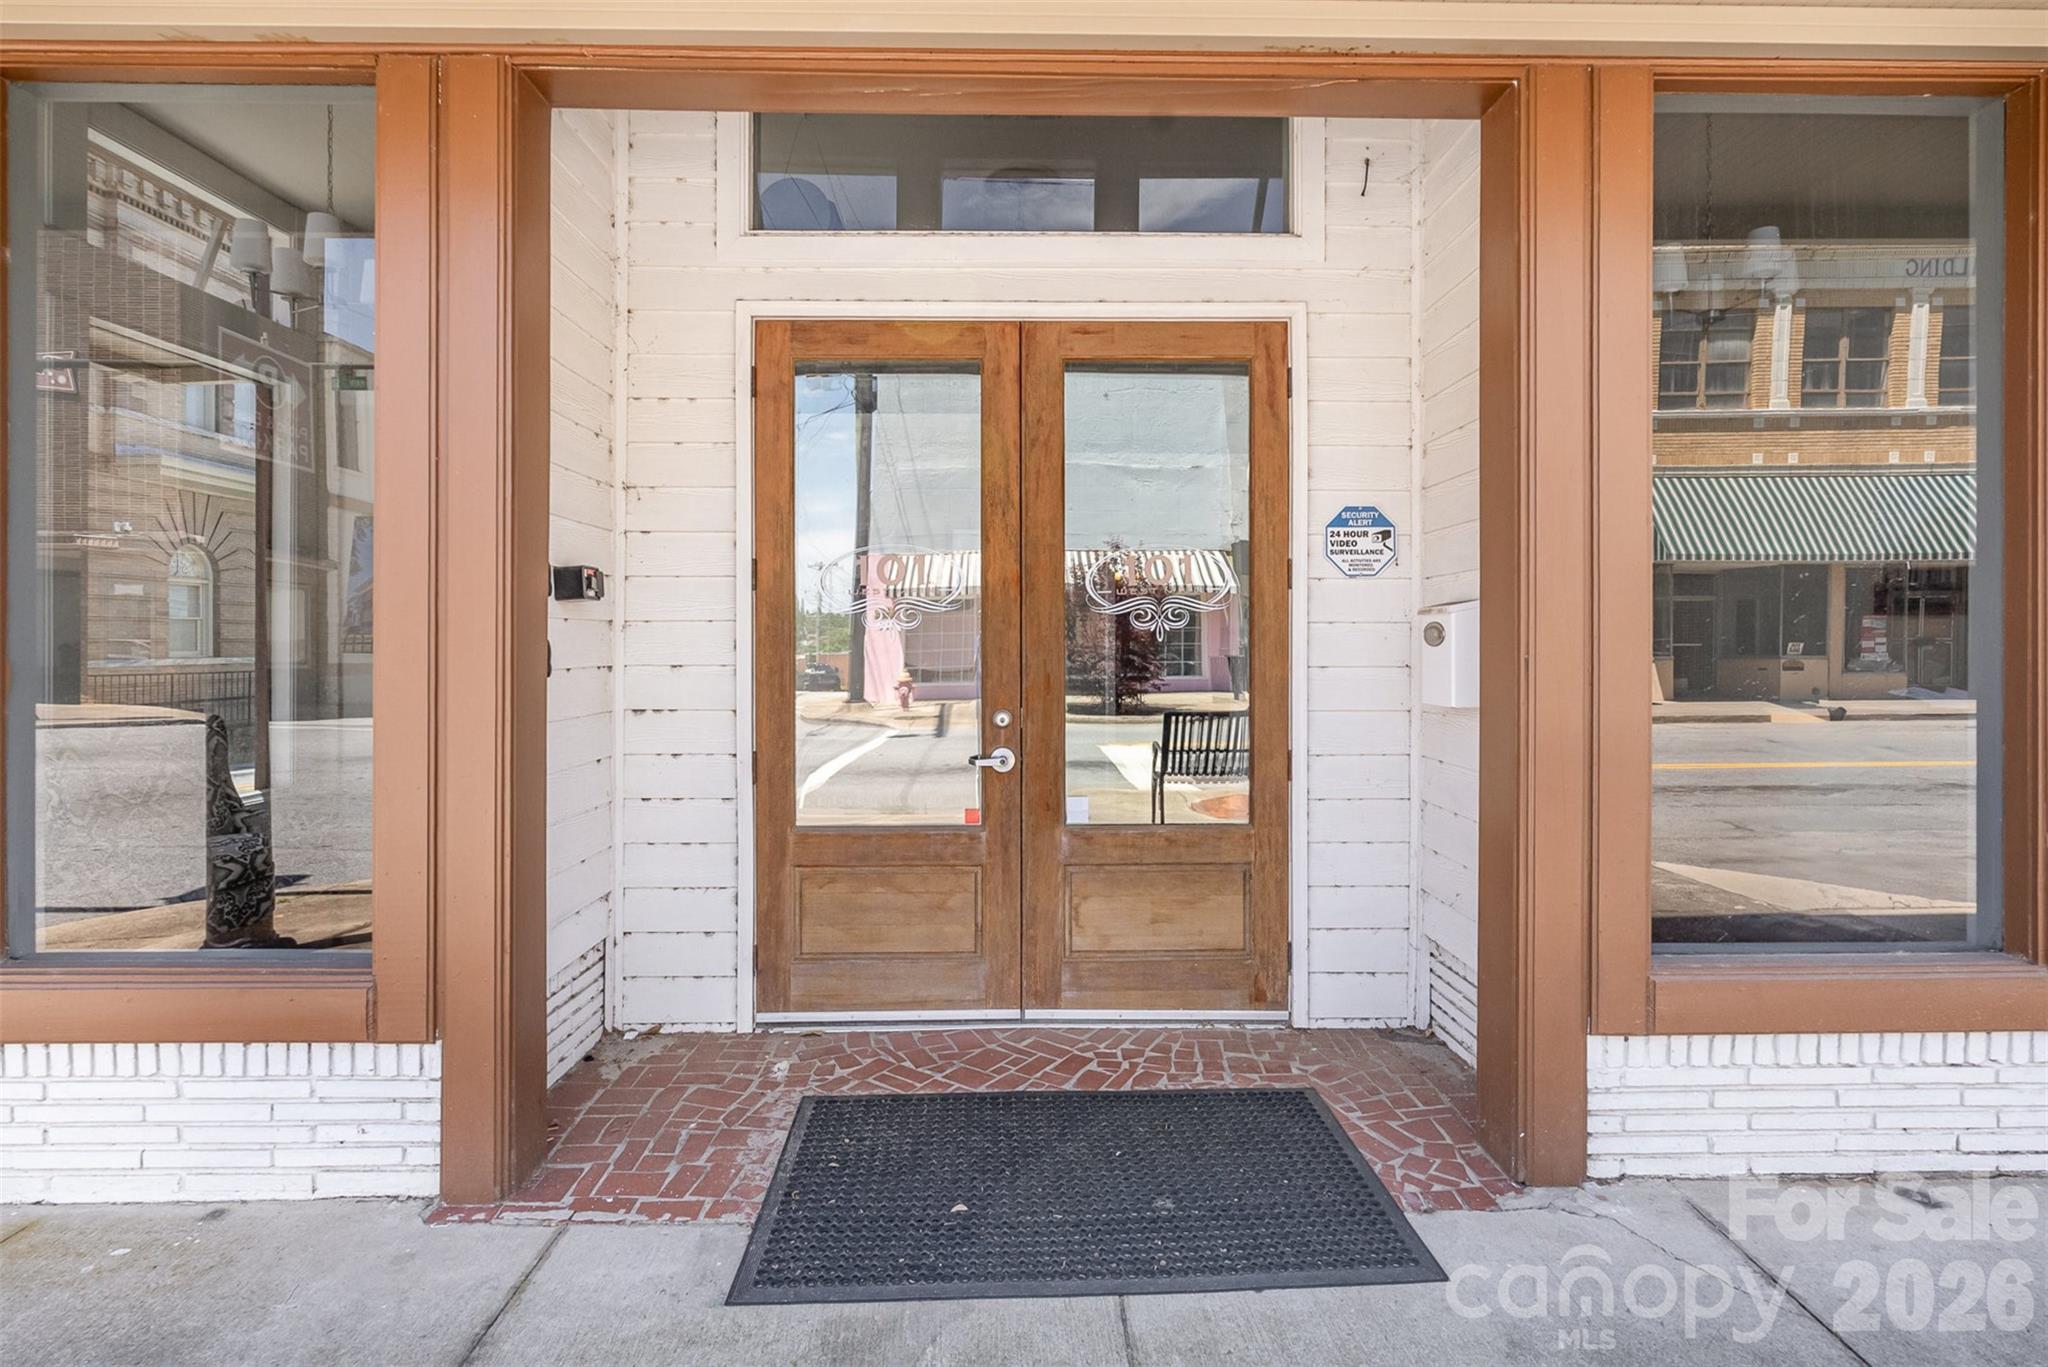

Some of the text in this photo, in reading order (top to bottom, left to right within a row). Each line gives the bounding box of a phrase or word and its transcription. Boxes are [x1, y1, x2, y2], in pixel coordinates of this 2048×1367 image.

[1341, 511, 1379, 519] SECURITY
[1329, 530, 1369, 538] 24 HOUR
[857, 554, 924, 585] 101
[1125, 555, 1192, 585] 101
